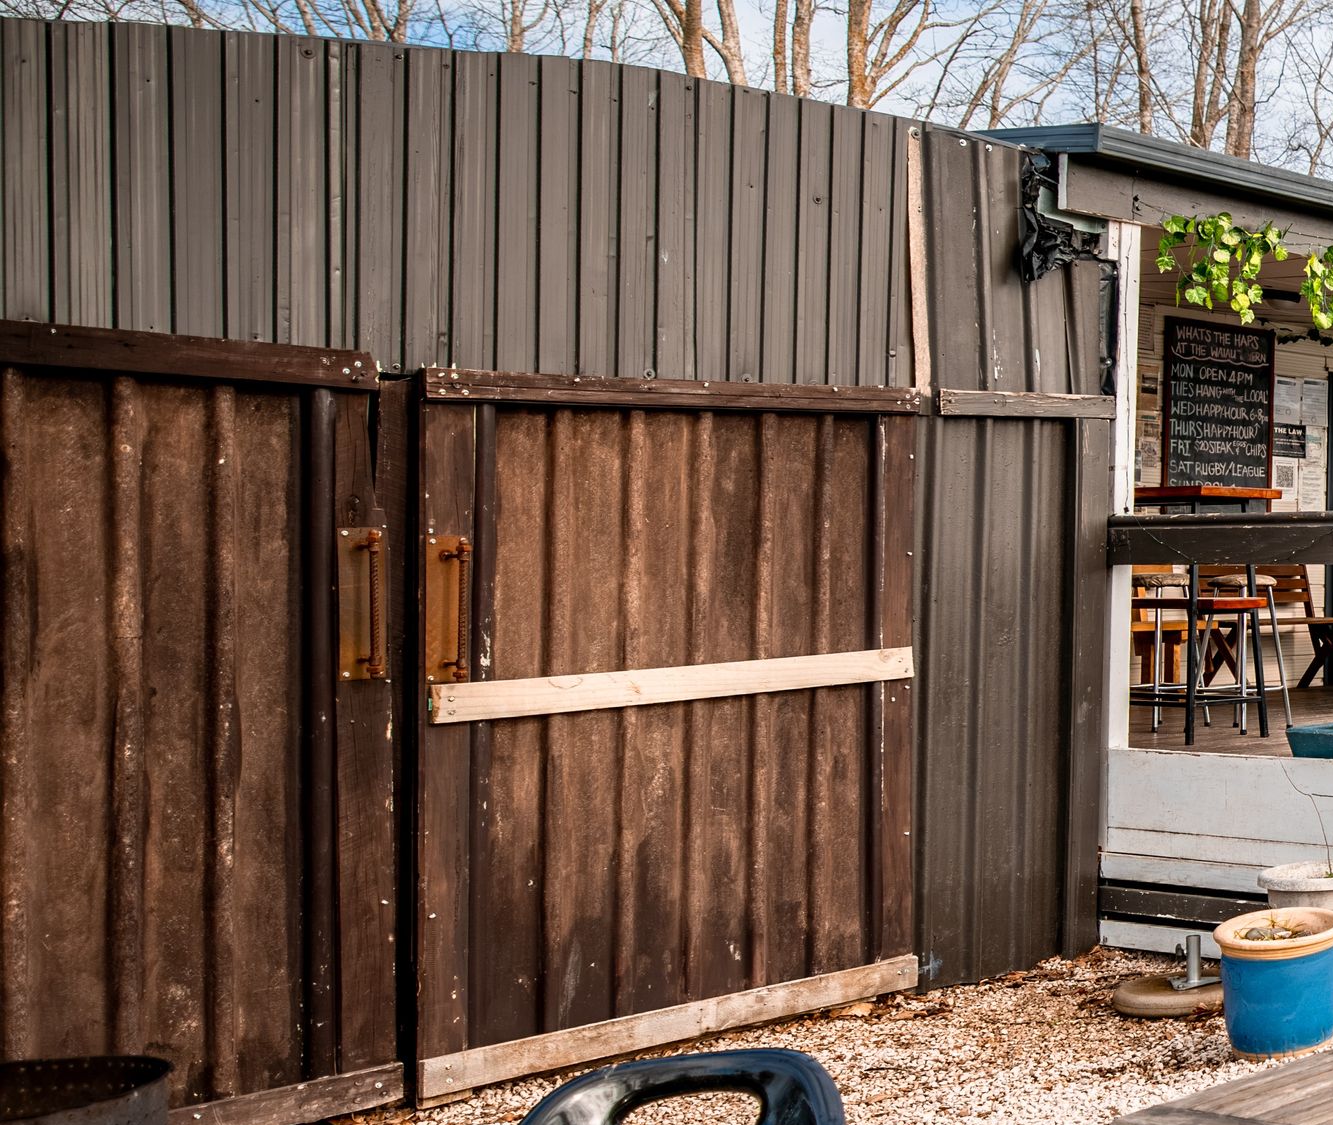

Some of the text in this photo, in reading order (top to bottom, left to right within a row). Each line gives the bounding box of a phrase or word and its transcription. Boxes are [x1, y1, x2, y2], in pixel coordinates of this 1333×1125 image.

[1214, 331, 1231, 345] THE
[1234, 334, 1260, 350] HAPS
[1176, 342, 1188, 353] AT
[1190, 343, 1207, 356] THE
[1211, 347, 1237, 359] WAIAU
[1171, 363, 1194, 379] MON
[1200, 366, 1227, 381] OPEN
[1170, 381, 1194, 398] TUES
[1196, 384, 1222, 399] HANG
[1171, 400, 1195, 416] WED
[1196, 403, 1225, 418] HAPPY
[1225, 406, 1249, 420] HOUR
[1169, 419, 1203, 439] THURS
[1203, 422, 1232, 438] HAPPY
[1170, 439, 1191, 456] FRI
[1245, 443, 1267, 458] CHIPS
[1169, 460, 1194, 473] SAT
